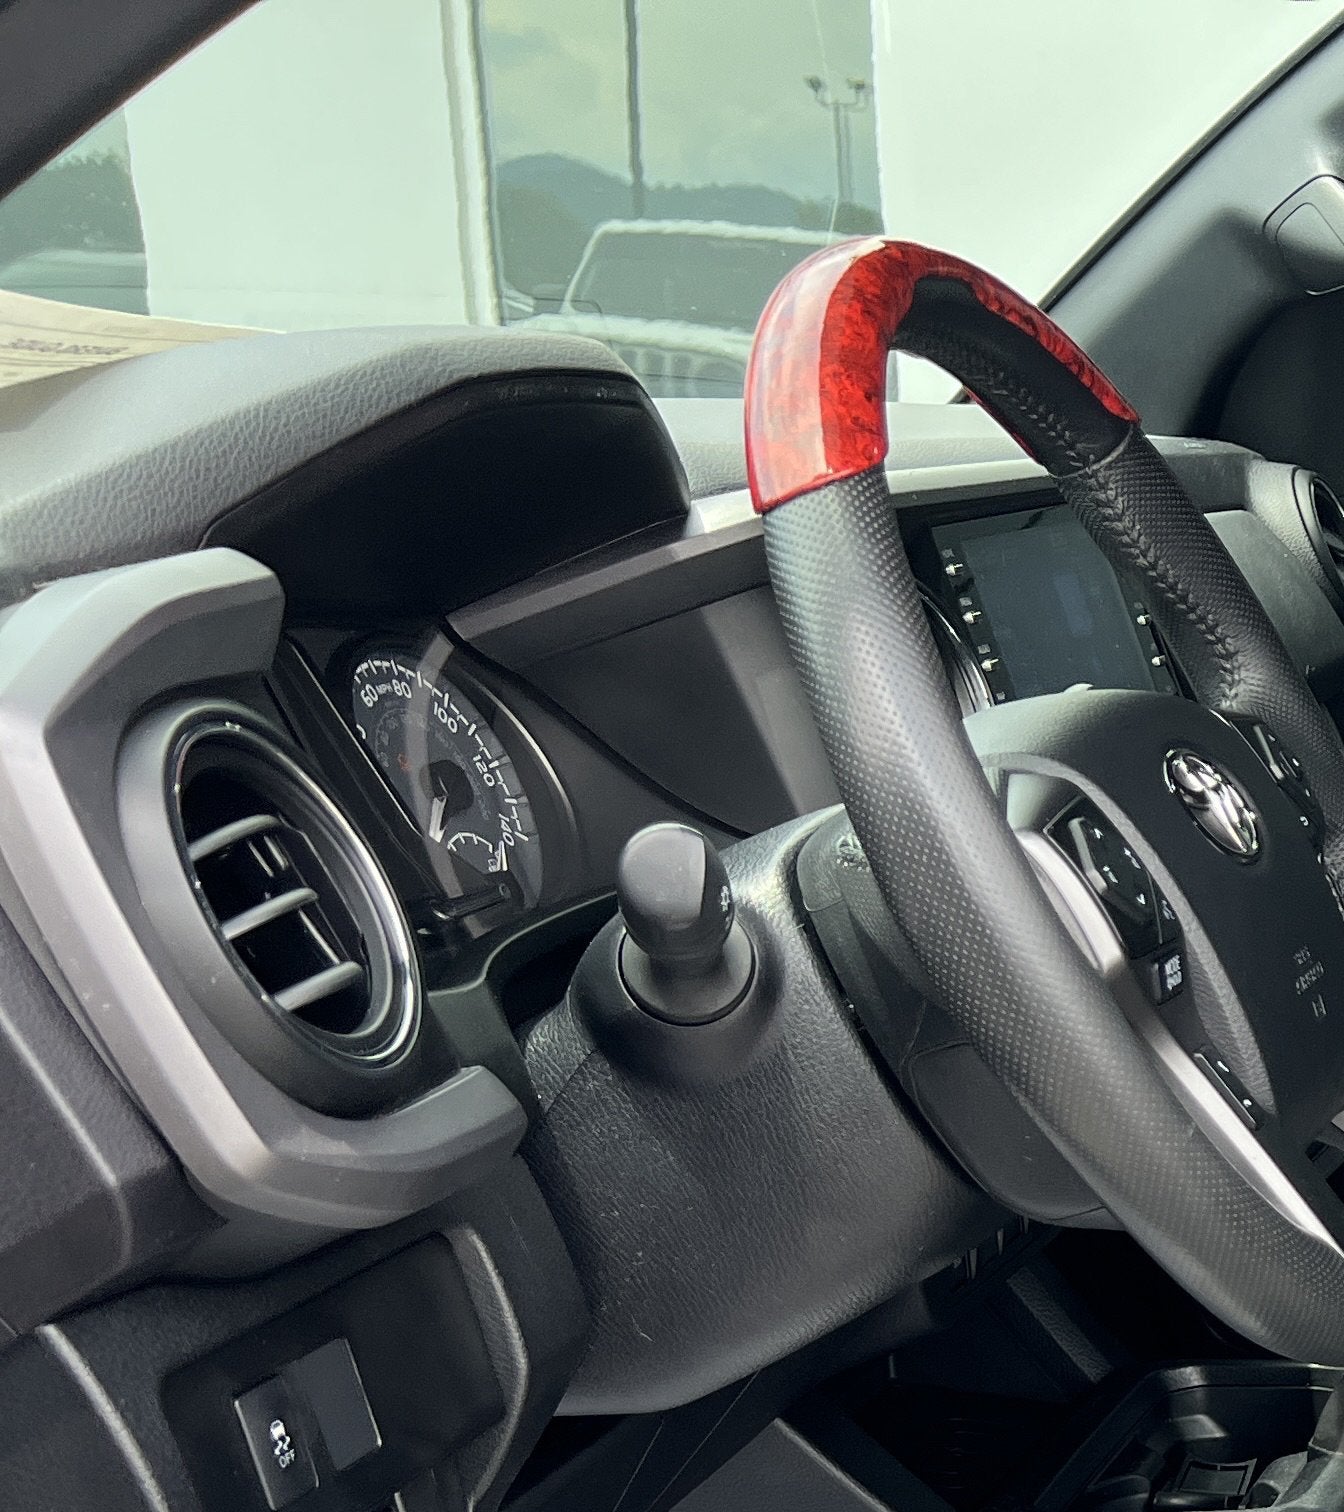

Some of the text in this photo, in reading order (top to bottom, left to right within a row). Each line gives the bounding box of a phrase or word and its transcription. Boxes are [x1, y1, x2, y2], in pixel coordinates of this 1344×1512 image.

[360, 683, 379, 708] 60
[391, 679, 412, 699] 80
[432, 702, 458, 734] 100
[472, 754, 496, 787] 120
[498, 812, 516, 847] 140
[278, 1449, 296, 1469] OFF
